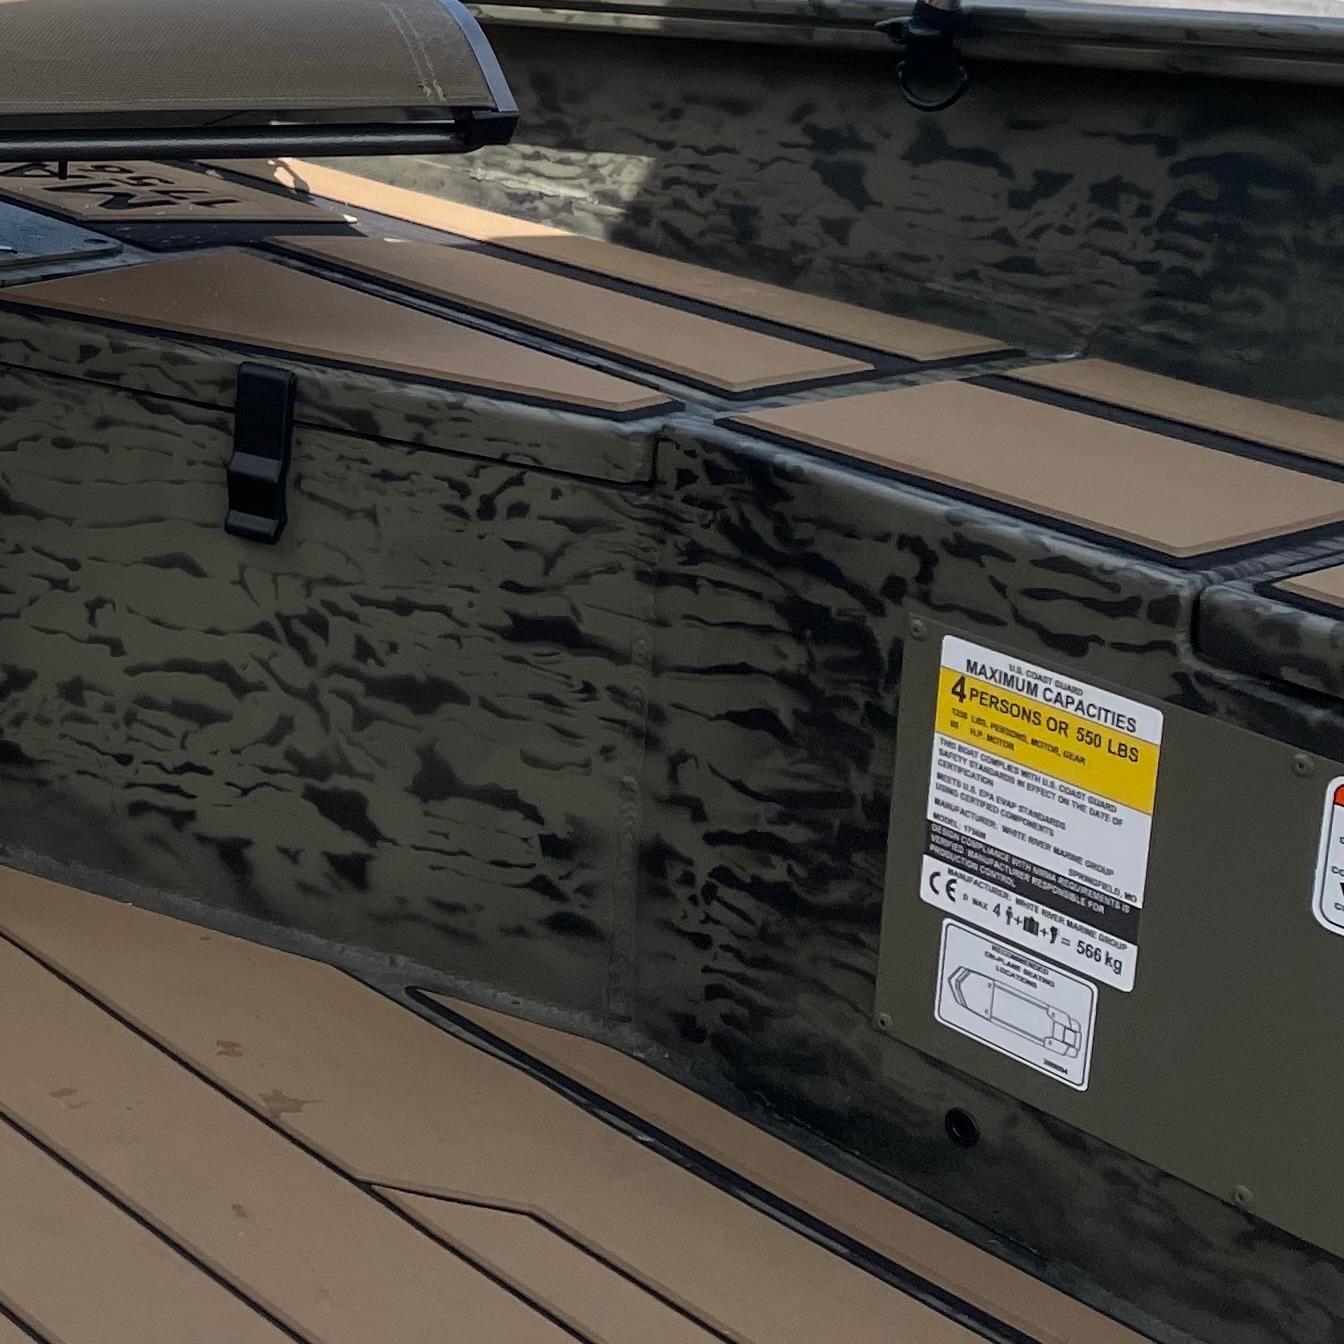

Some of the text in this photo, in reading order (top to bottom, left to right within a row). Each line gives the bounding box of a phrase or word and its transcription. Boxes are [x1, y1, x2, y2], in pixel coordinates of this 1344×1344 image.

[951, 675, 1139, 762] 4 PERSONS OR 550 LBS
[966, 659, 1136, 733] MAXIMUM CAPACITIES
[993, 903, 1001, 917] 4
[1077, 940, 1101, 962] 566
[1104, 951, 1122, 975] kg
